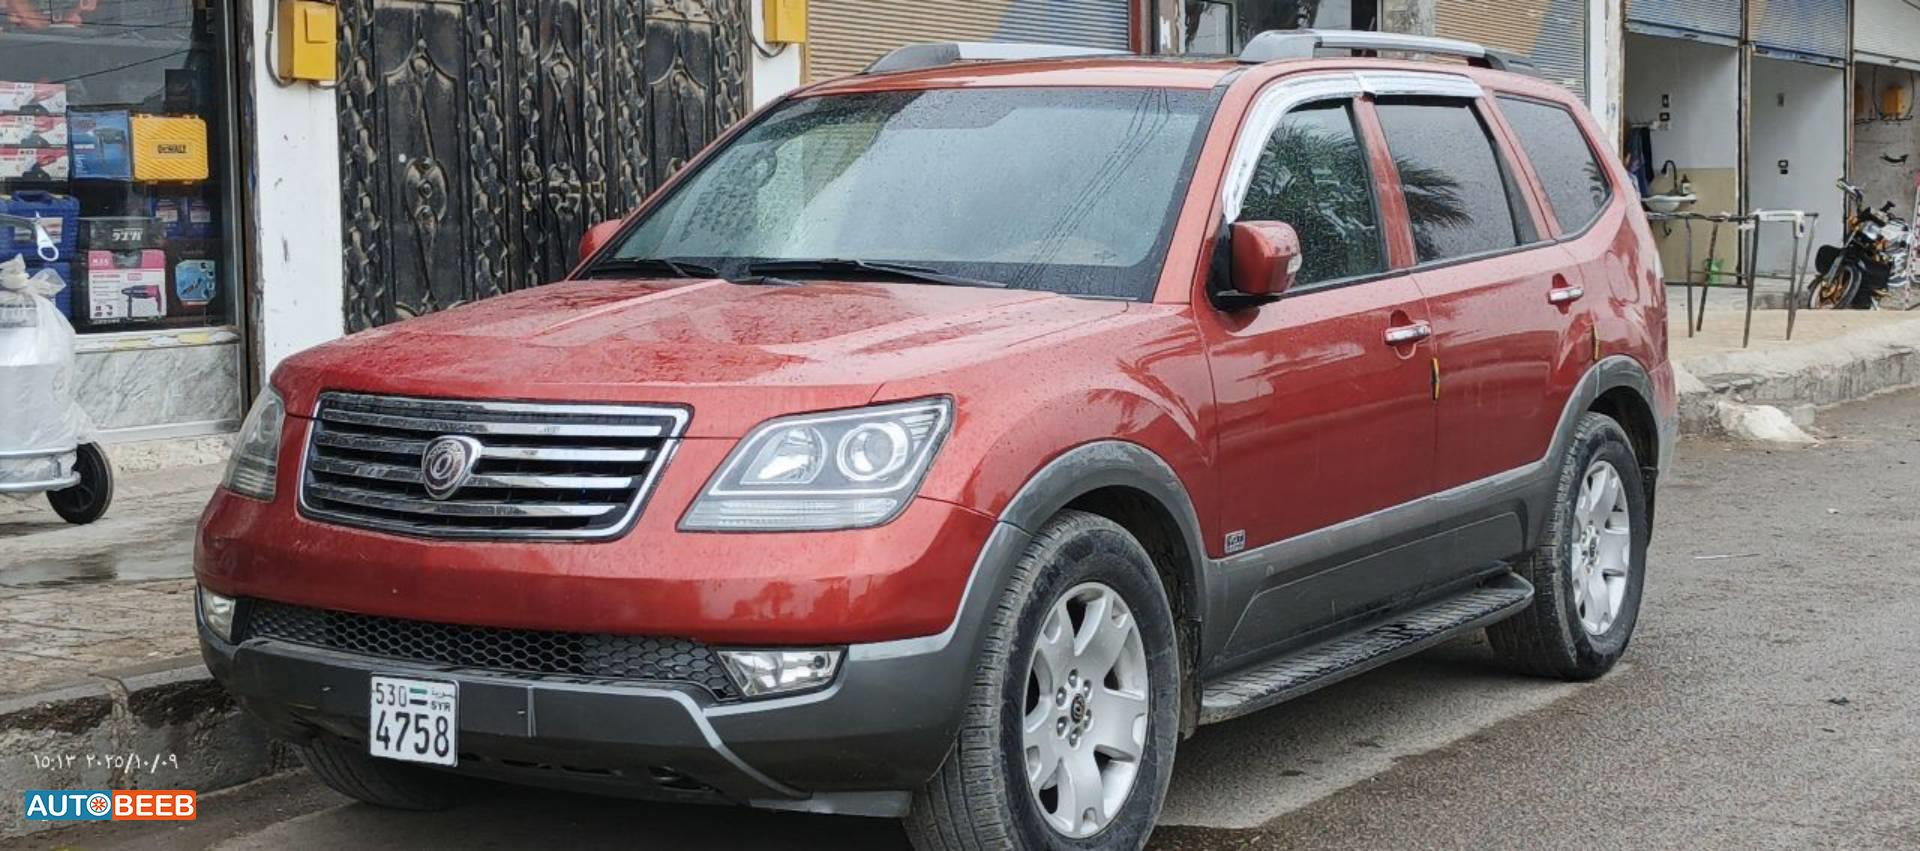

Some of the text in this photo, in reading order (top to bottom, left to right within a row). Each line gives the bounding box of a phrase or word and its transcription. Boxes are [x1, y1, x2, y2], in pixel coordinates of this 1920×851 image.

[376, 682, 407, 707] 530
[431, 700, 451, 712] SYR
[376, 710, 449, 758] 4758
